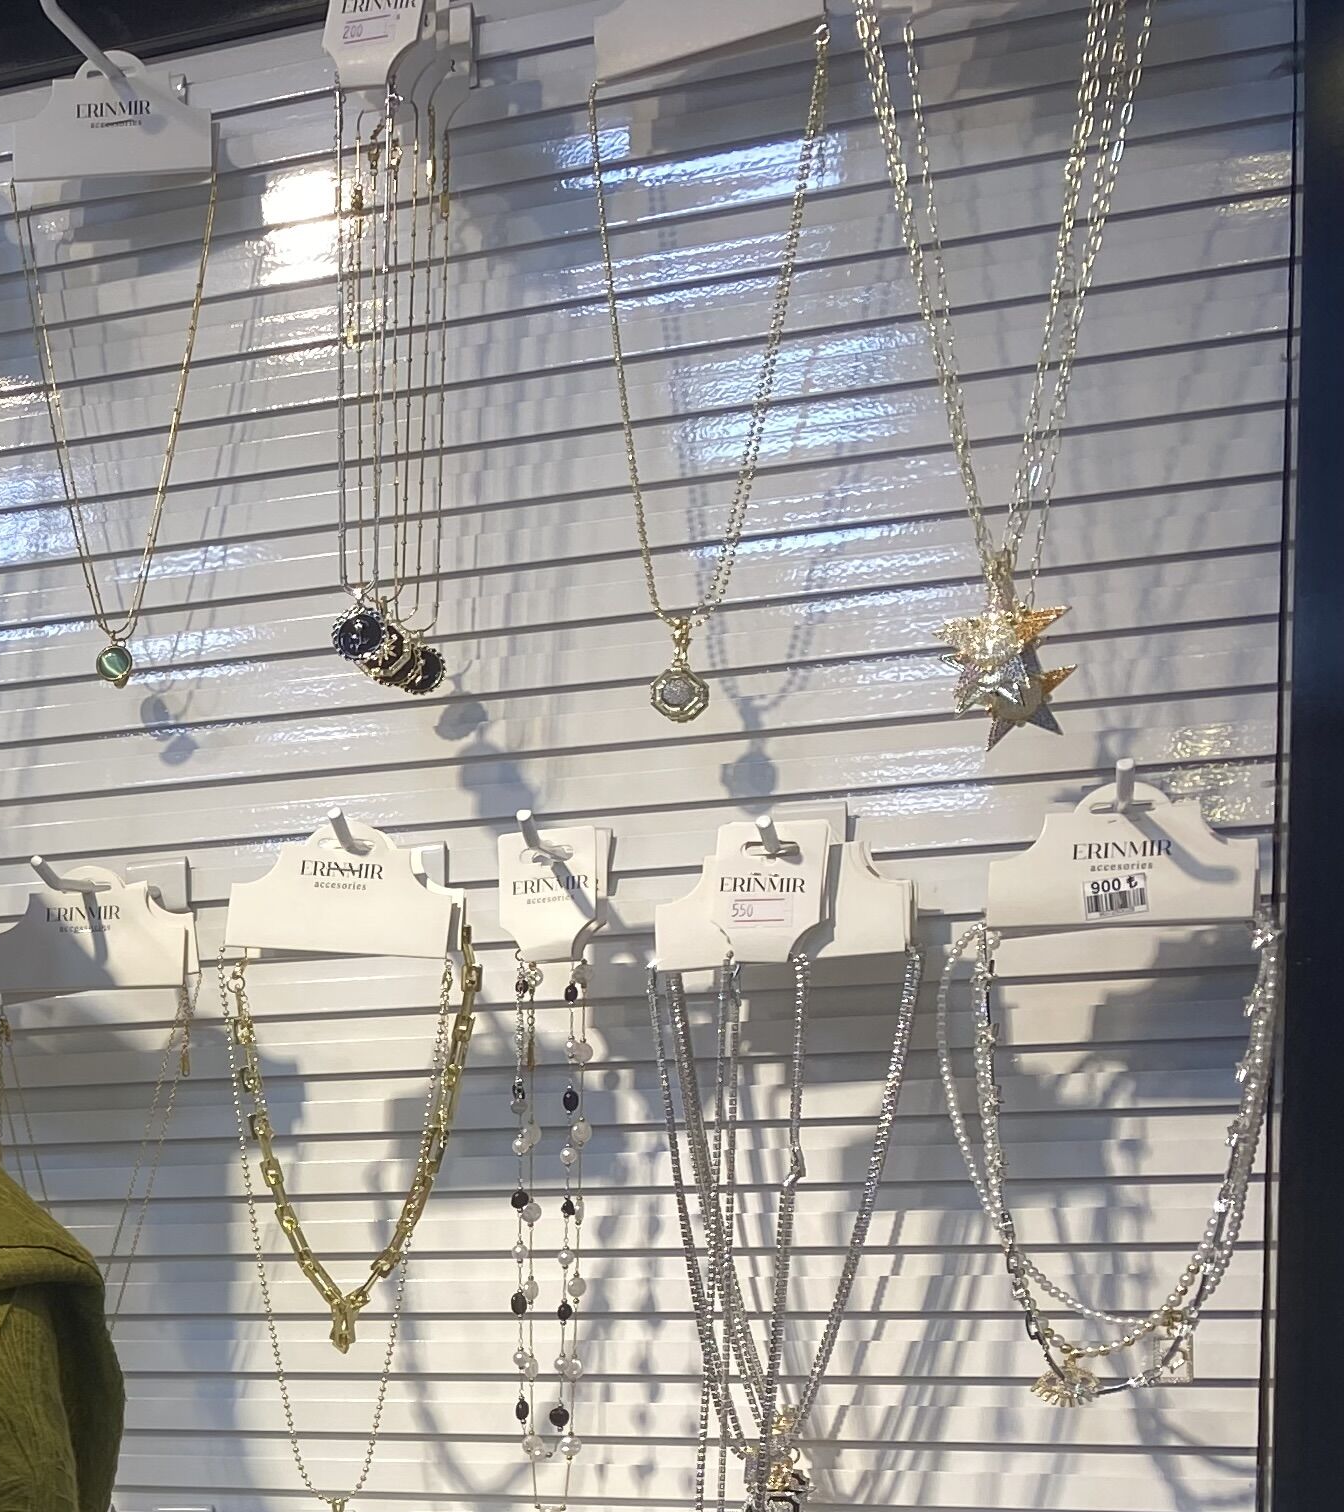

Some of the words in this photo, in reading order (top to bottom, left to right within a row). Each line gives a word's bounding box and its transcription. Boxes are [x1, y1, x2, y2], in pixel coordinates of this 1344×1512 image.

[76, 99, 152, 119] ERINMIR
[1073, 839, 1173, 860] ERINMIR
[300, 859, 385, 880] ERINMIR
[1090, 861, 1153, 872] accesories
[314, 880, 367, 891] accesories
[512, 874, 589, 896] ERINMIR
[720, 875, 806, 894] ERINMIR
[1091, 878, 1121, 894] 900
[46, 904, 121, 922] ERINMIR
[731, 903, 754, 918] 550
